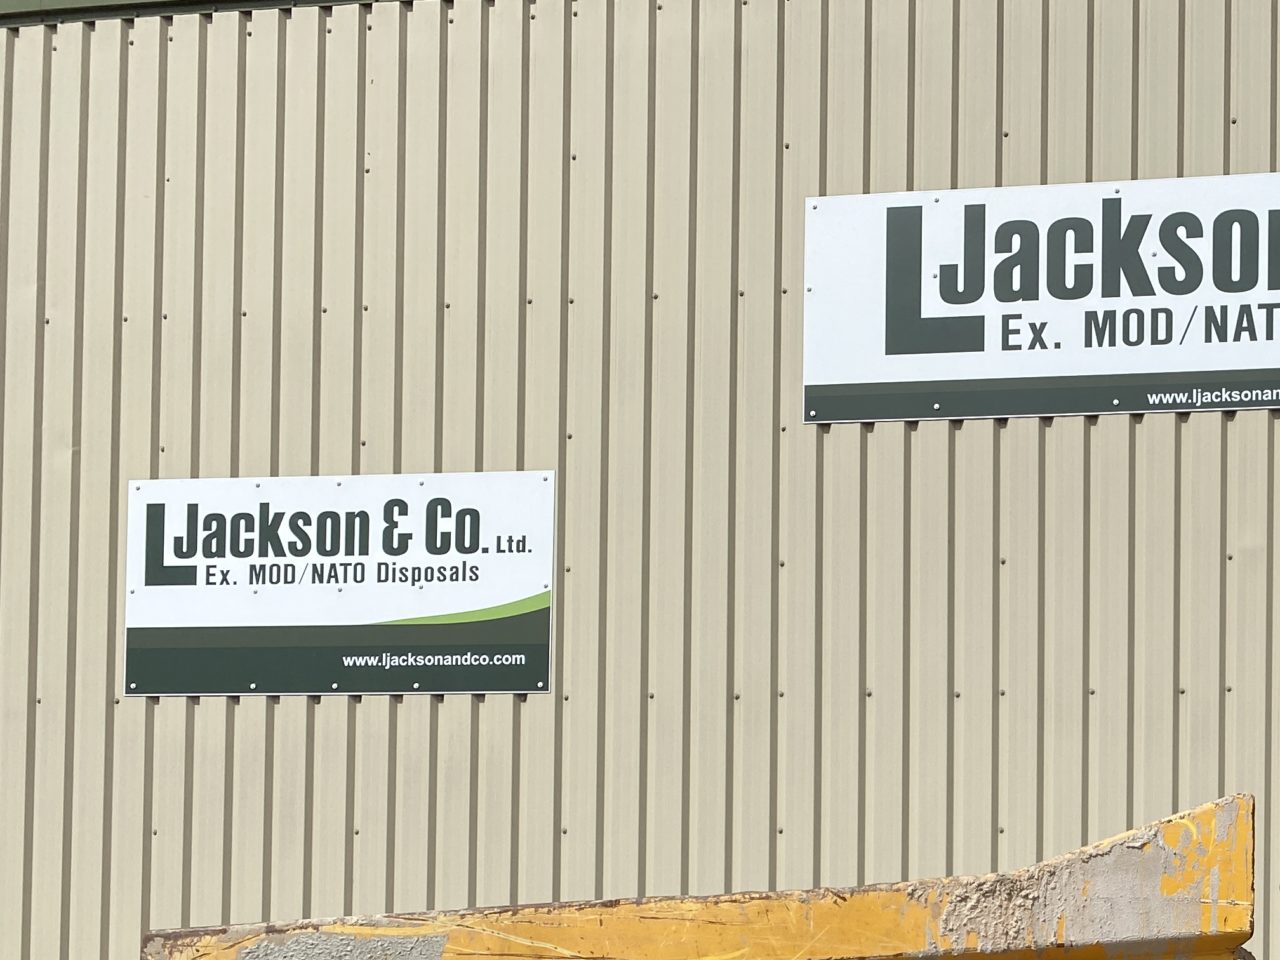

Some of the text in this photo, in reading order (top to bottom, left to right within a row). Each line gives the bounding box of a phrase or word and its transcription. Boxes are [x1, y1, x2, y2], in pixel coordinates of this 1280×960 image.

[1001, 313, 1061, 351] Ex.
[382, 498, 413, 557] &
[425, 497, 489, 556] Co.
[496, 535, 532, 554] Ltd.
[205, 560, 480, 587] Ex. MOD/NATO Disposals
[342, 651, 526, 670] www.ljacksonandco.com
